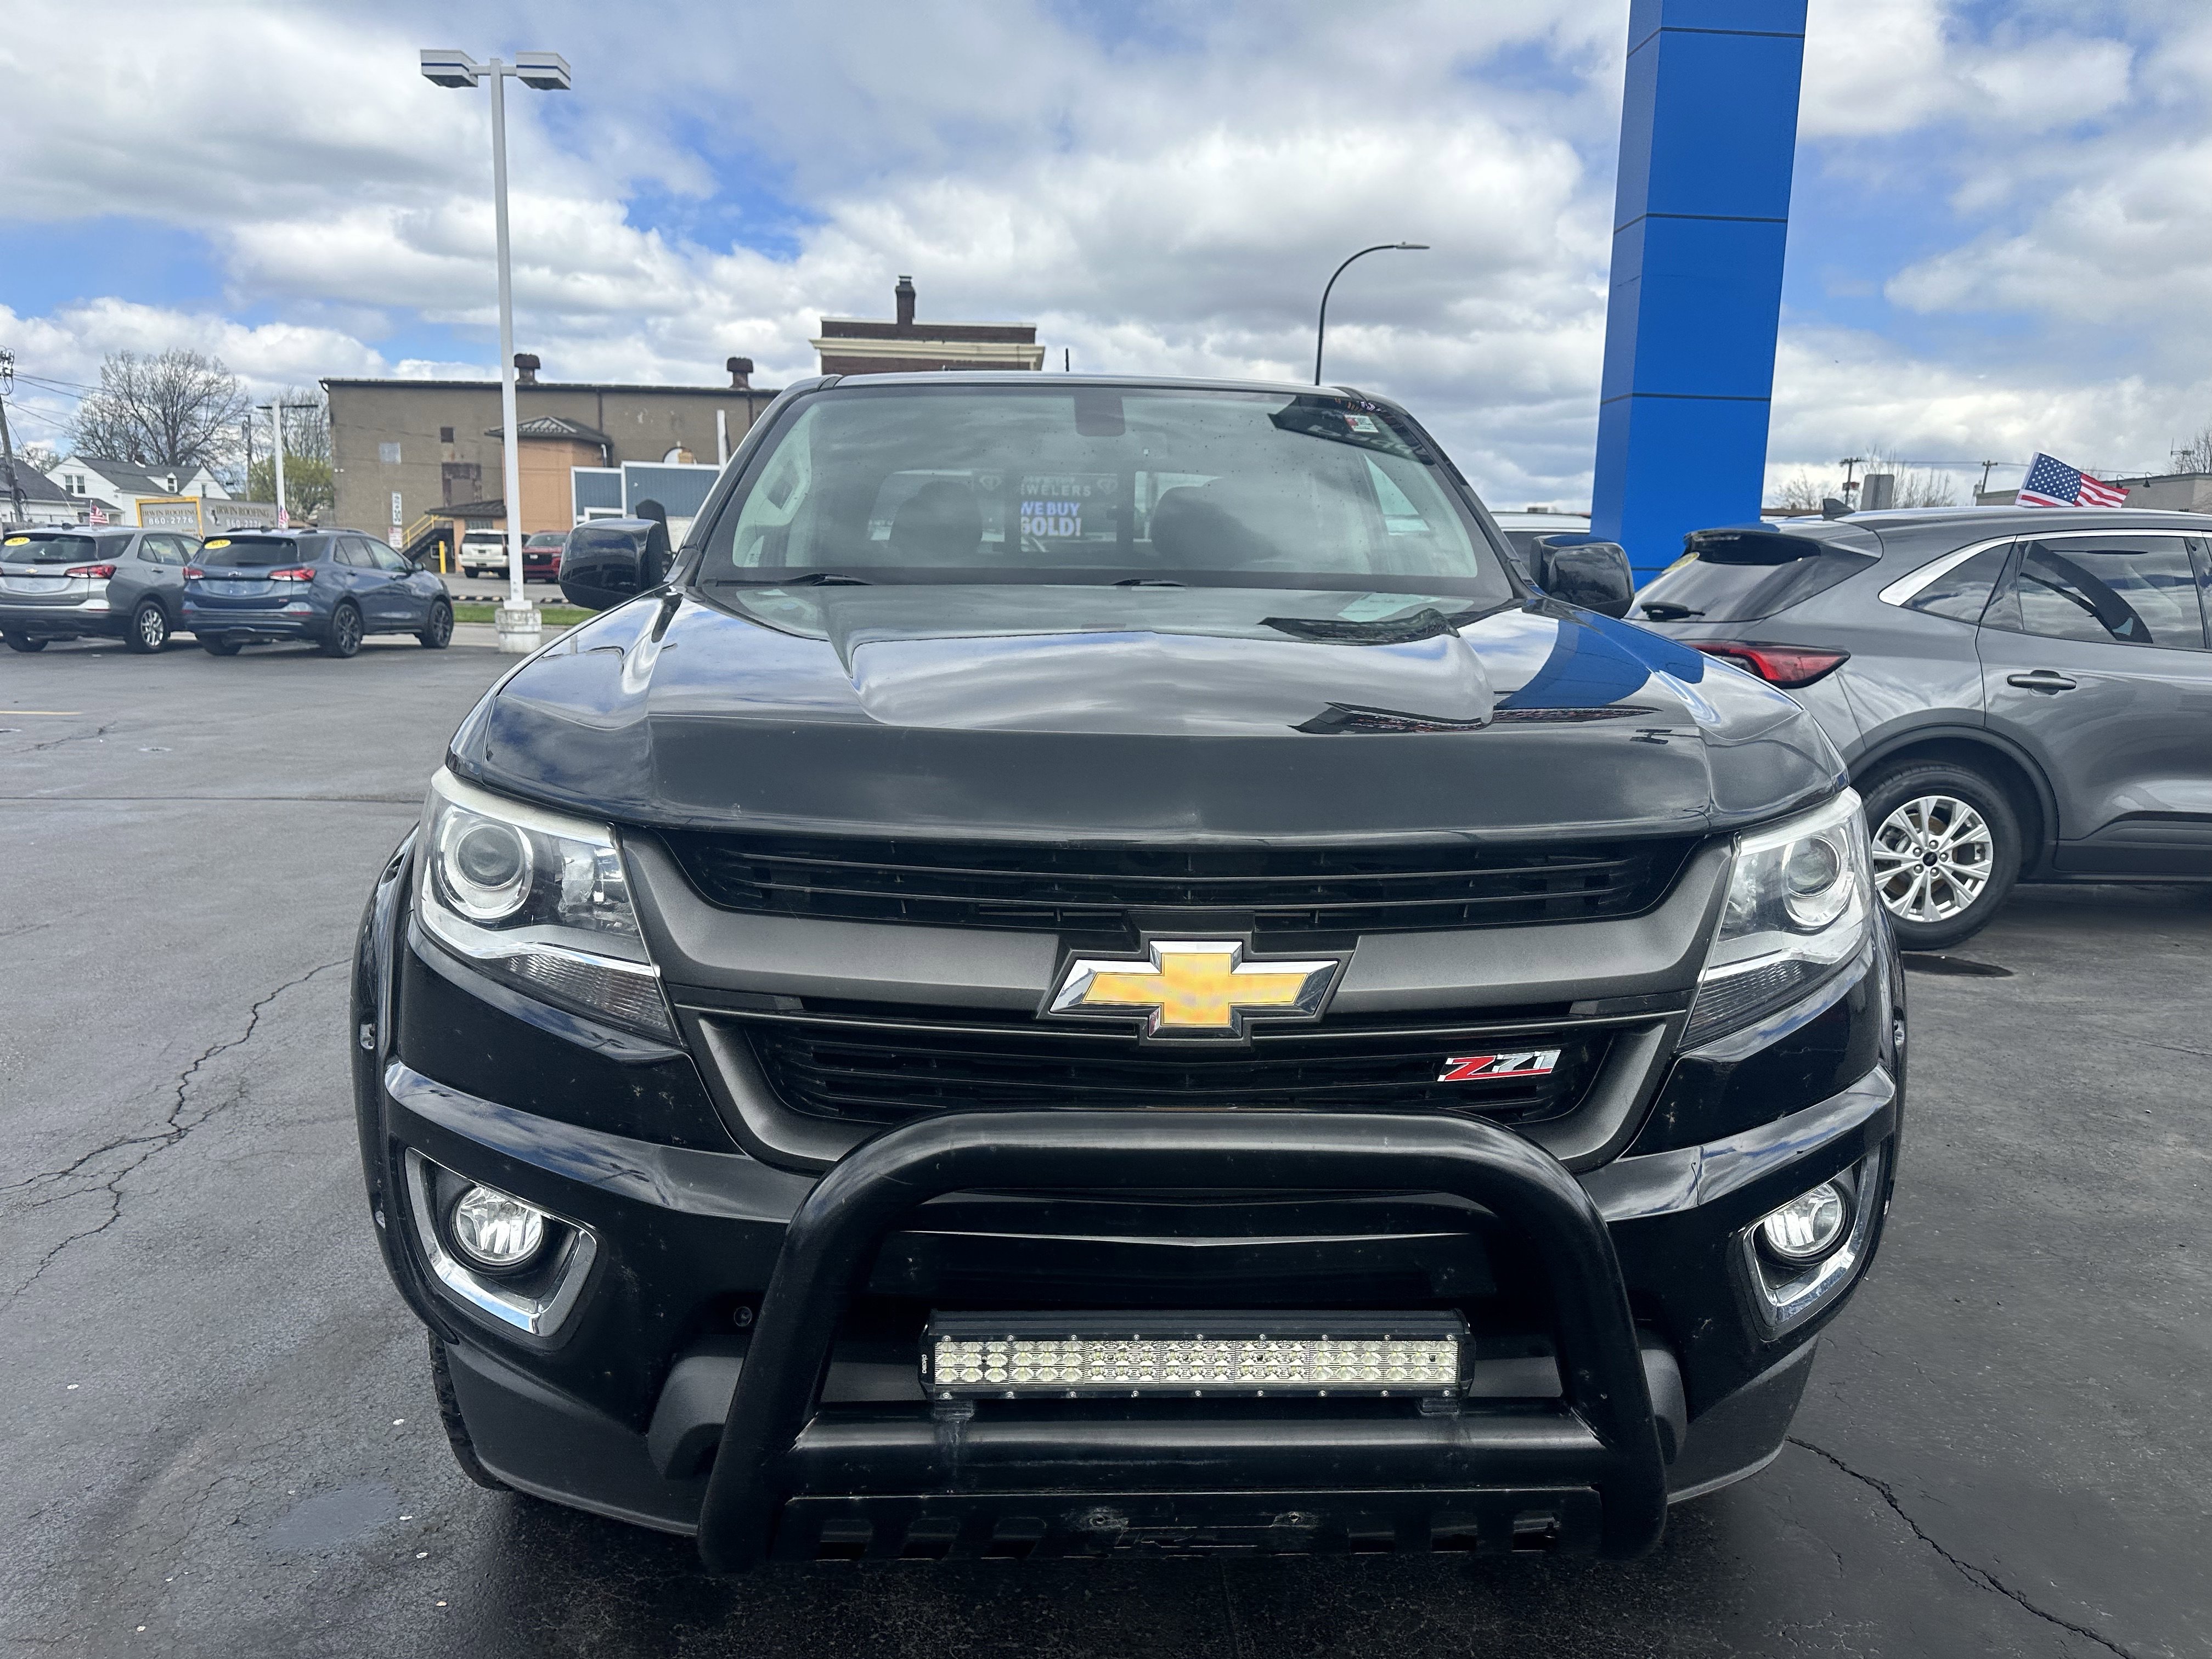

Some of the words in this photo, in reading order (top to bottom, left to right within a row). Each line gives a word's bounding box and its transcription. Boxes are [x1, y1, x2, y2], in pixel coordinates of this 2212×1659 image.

[165, 508, 198, 517] ROOFING
[216, 505, 237, 516] IRWIN
[238, 506, 269, 518] ROOFING
[1046, 501, 1081, 517] BUY
[149, 516, 194, 525] 860-2776
[1437, 1049, 1561, 1082] Z71
